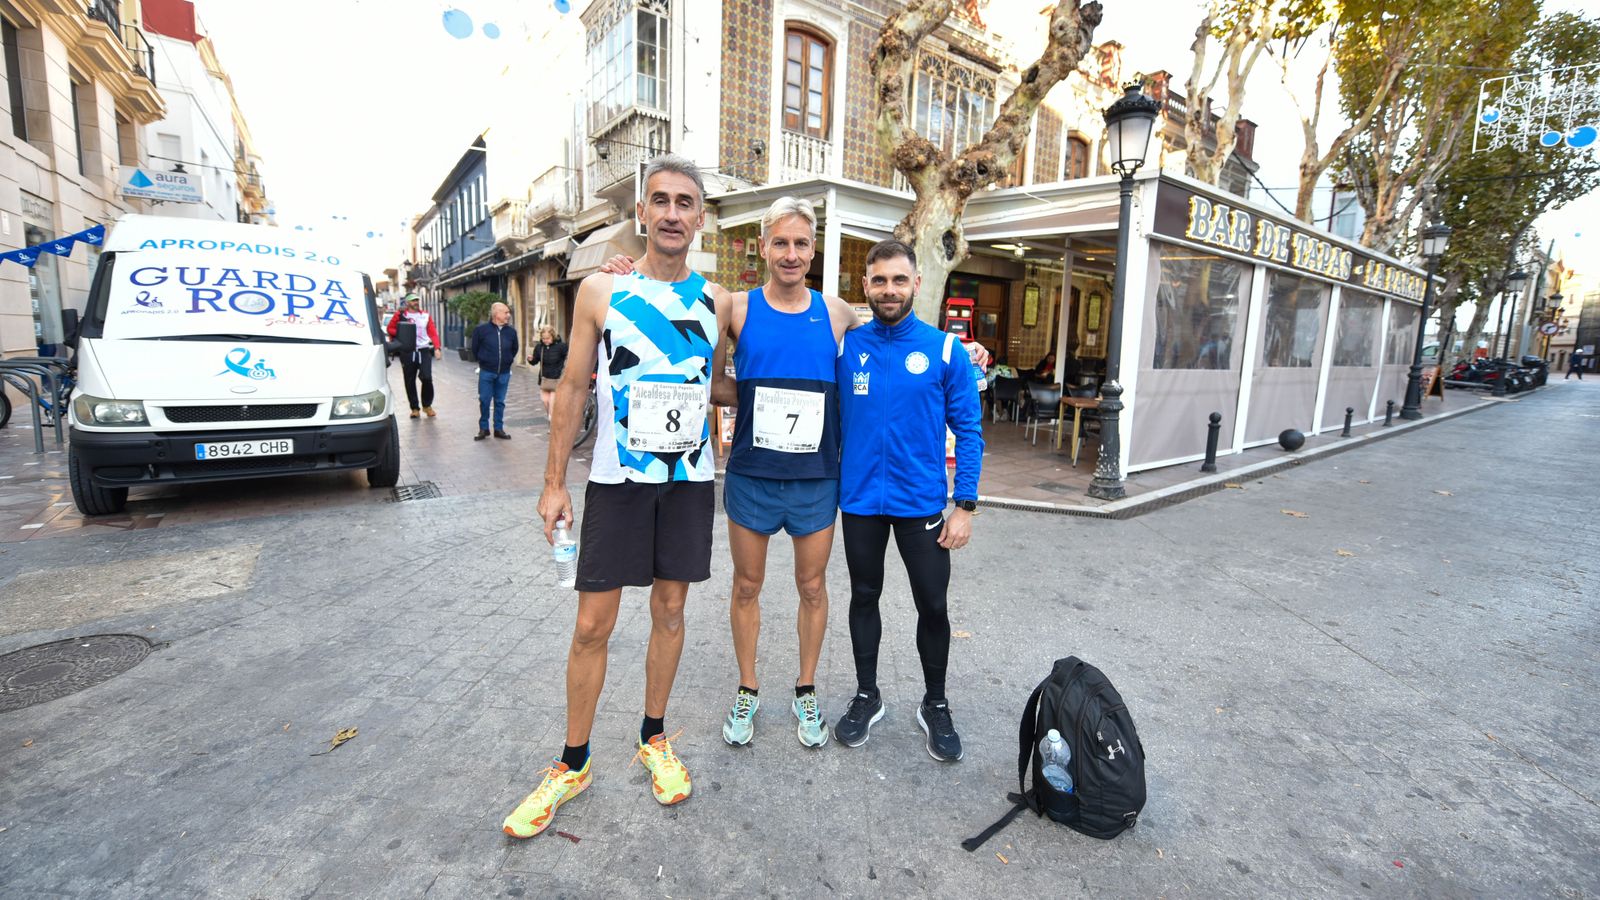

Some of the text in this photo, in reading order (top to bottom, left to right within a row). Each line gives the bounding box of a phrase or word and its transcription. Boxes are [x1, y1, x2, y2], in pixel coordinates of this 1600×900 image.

[155, 173, 187, 184] aura
[156, 182, 196, 192] seguros
[139, 239, 340, 266] APROPADIS 2.0
[1186, 195, 1251, 252] BAR
[1254, 219, 1291, 262] DE
[1292, 232, 1353, 281] TAPAS
[1363, 259, 1385, 291] LA
[129, 266, 351, 299] GUARDA
[185, 288, 358, 322] ROPA
[665, 409, 681, 433] 8
[785, 413, 799, 435] 7
[208, 444, 254, 457] 8942
[260, 441, 289, 453] CHB
